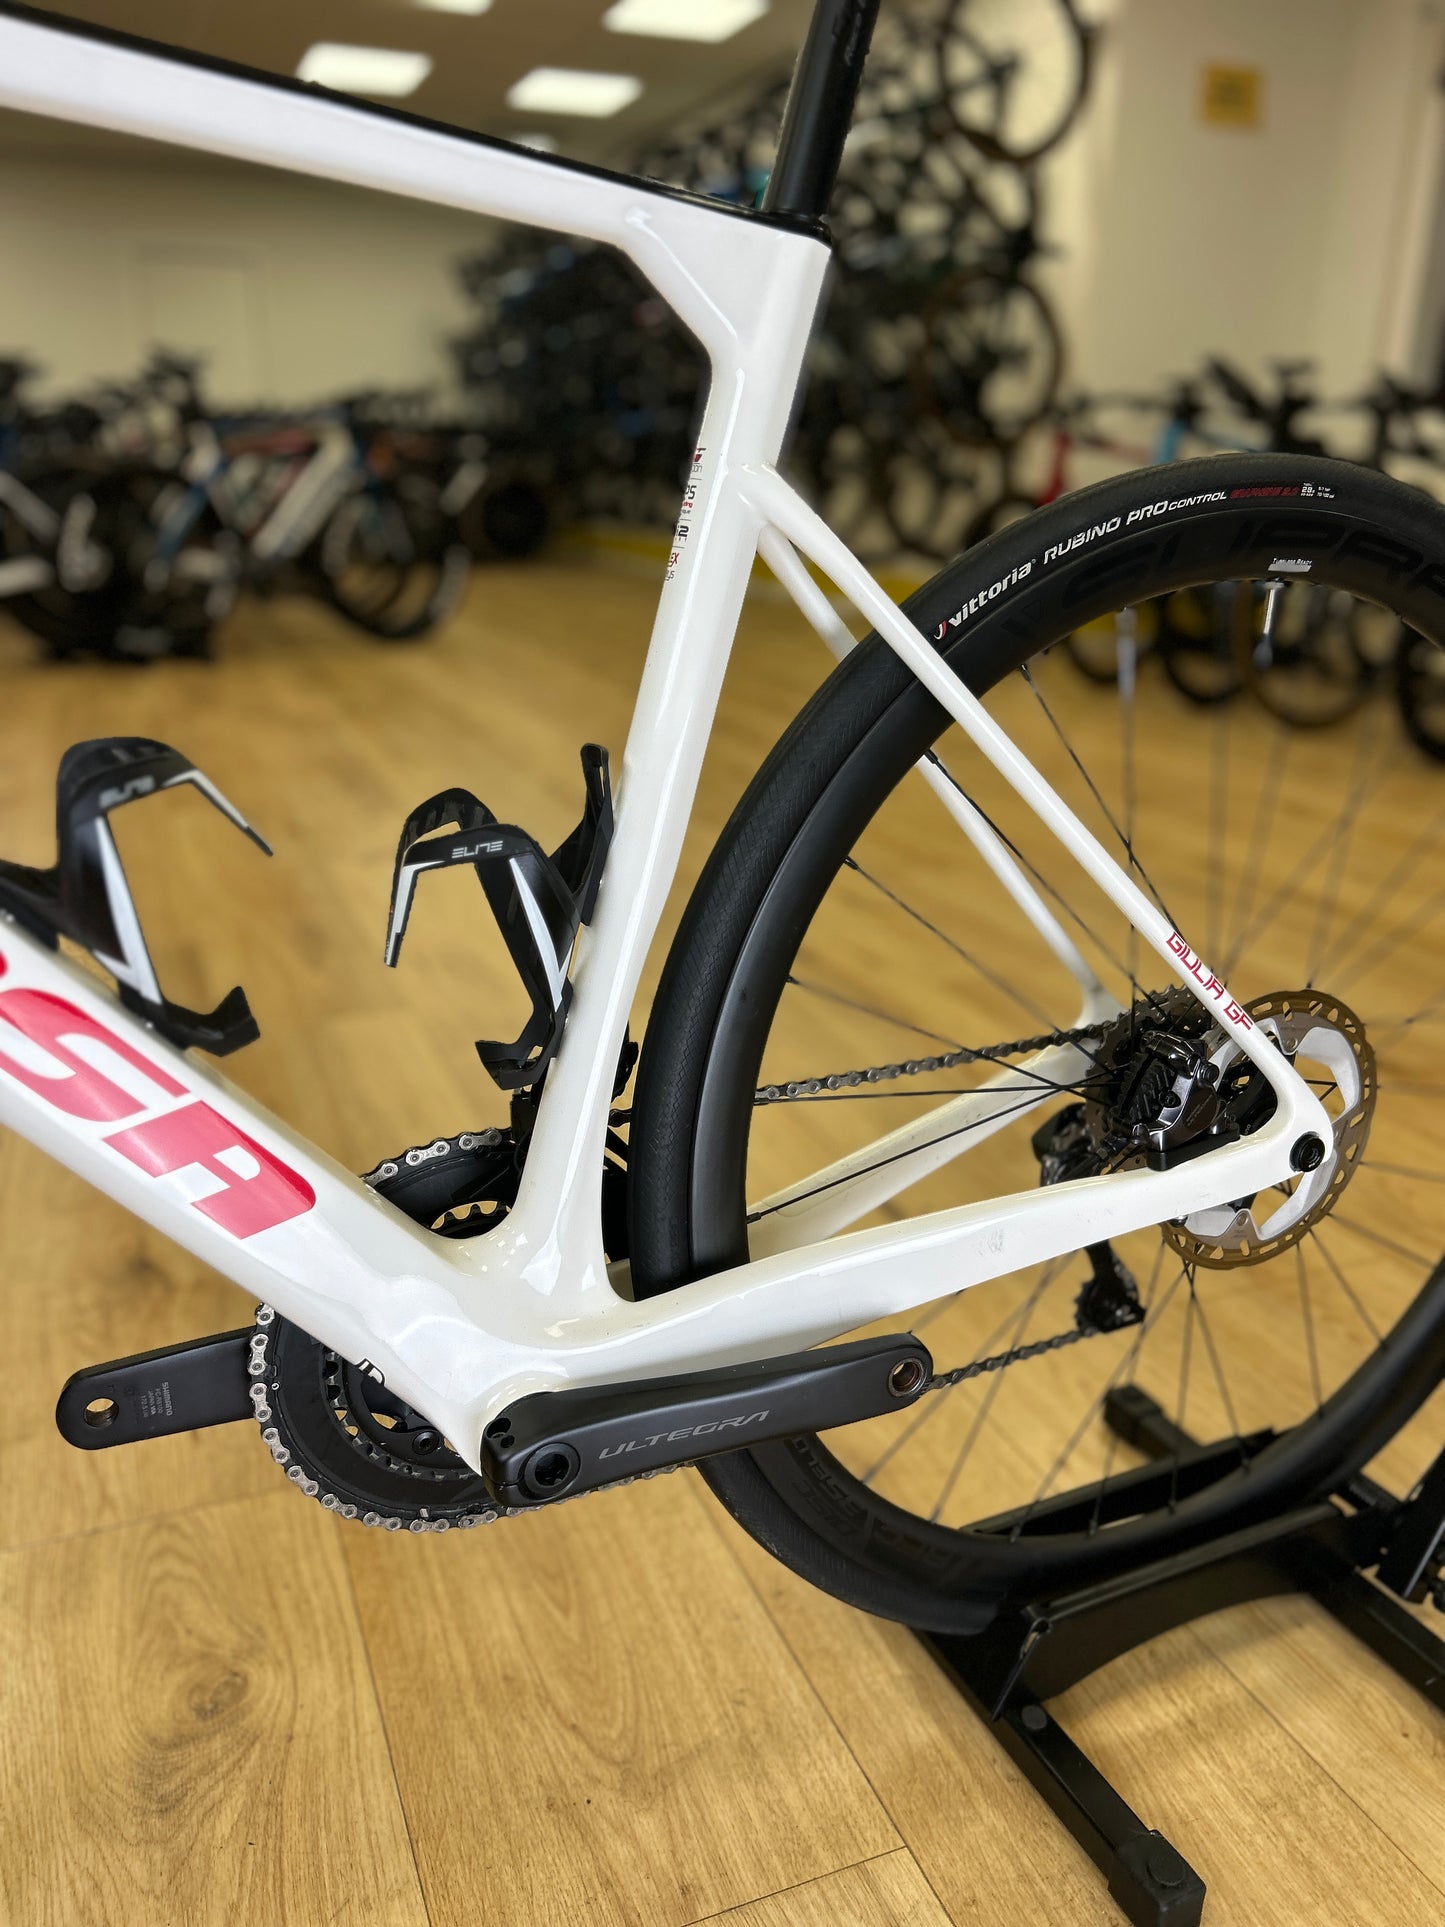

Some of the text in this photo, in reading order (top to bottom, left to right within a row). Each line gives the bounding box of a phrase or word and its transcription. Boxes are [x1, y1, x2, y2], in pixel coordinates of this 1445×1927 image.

[948, 561, 1032, 628] vittoria
[1043, 516, 1121, 565] RUBINO
[1126, 500, 1168, 526] PRO
[1168, 490, 1228, 511] CONTROL
[451, 840, 504, 859] ELITE
[1166, 931, 1254, 1031] GIULIA GF
[162, 1382, 172, 1415] SHIMANO
[599, 1409, 770, 1460] ULTEGRA
